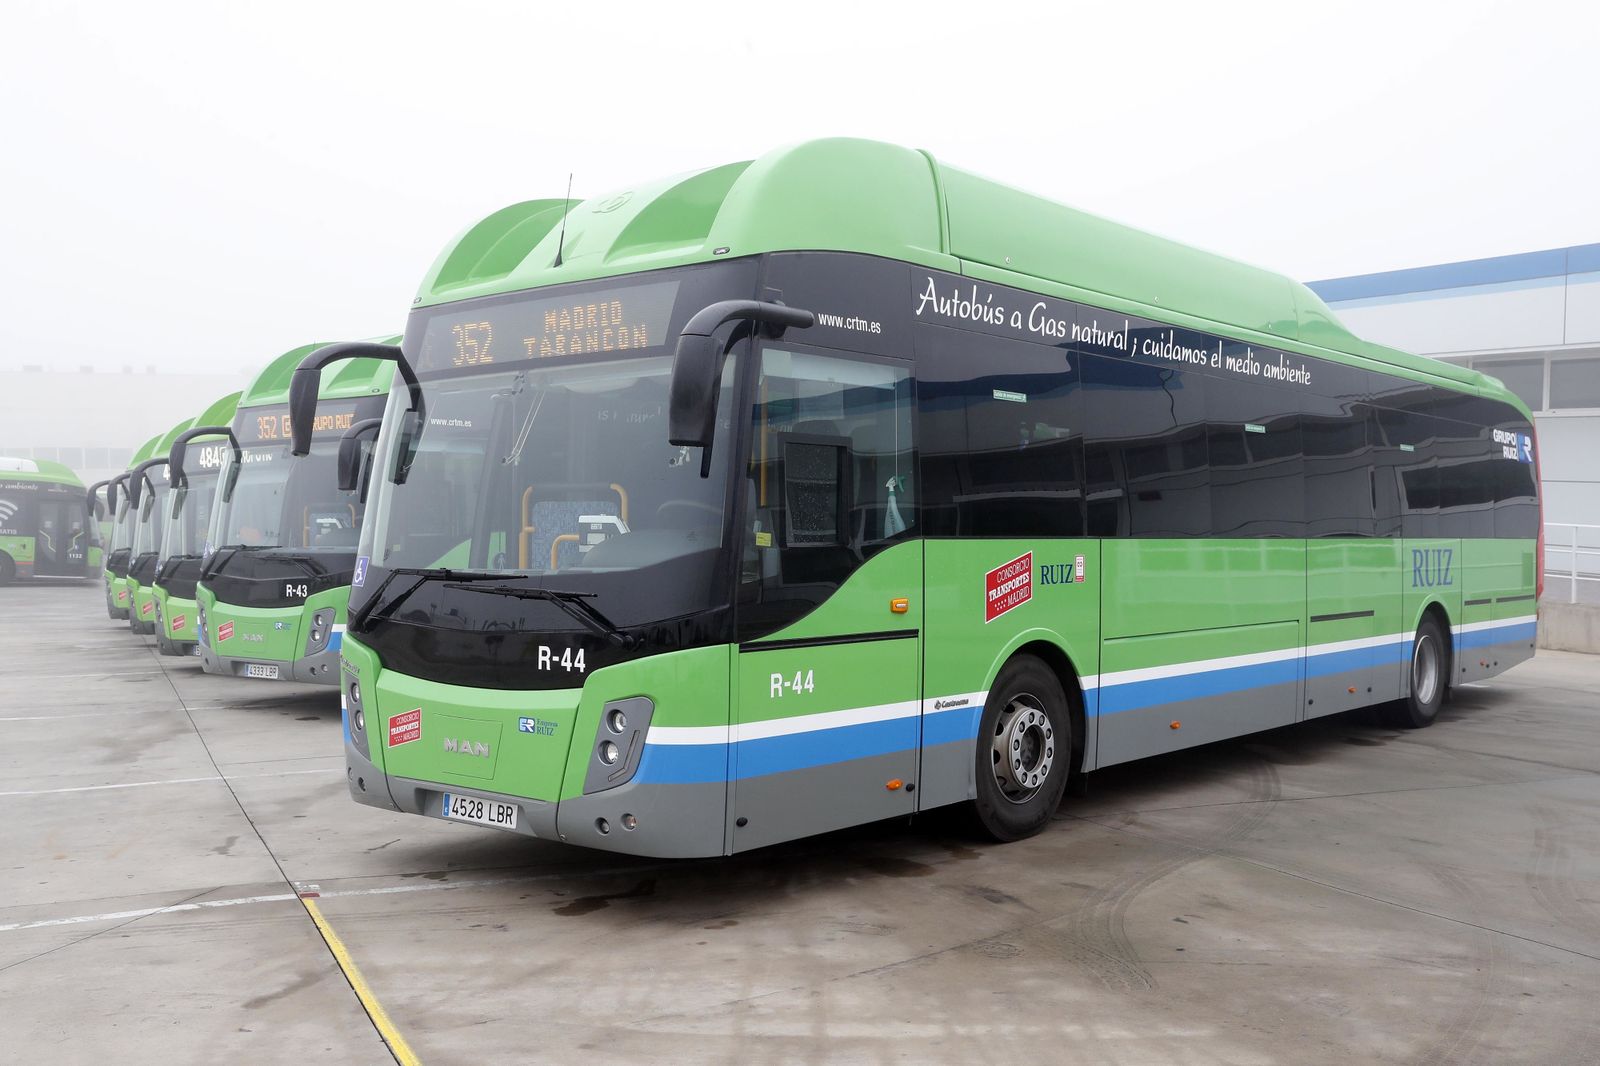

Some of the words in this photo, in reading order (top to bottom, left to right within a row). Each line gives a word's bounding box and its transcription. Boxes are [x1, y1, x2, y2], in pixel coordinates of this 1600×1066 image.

[544, 300, 622, 333] MADRID
[818, 312, 881, 334] www.crtm.es
[916, 277, 1004, 325] Autobús
[1010, 311, 1022, 329] a
[1028, 302, 1066, 339] Gas
[1071, 320, 1128, 351] natural
[1142, 330, 1207, 366] cuidamos
[1210, 340, 1222, 369] el
[1226, 347, 1260, 376] medio
[1263, 354, 1311, 386] ambiente
[451, 321, 493, 365] 352
[257, 416, 277, 439] 352
[312, 416, 334, 432] RUPO
[430, 417, 472, 428] www.crtm.es
[1493, 429, 1516, 446] GRUPO
[1503, 446, 1518, 460] RUIZ
[996, 557, 1030, 583] CONSORCIO
[1040, 564, 1074, 585] RUIZ
[1412, 549, 1453, 588] RUIZ
[286, 584, 308, 598] R-43
[988, 572, 1030, 602] TRANSPORTES
[1007, 586, 1030, 606] MADRID
[537, 645, 586, 672] R-44
[770, 670, 815, 698] R-44
[537, 727, 554, 736] RUIZ
[444, 737, 490, 758] MAN
[451, 797, 484, 820] 4528
[488, 802, 514, 826] LBR
